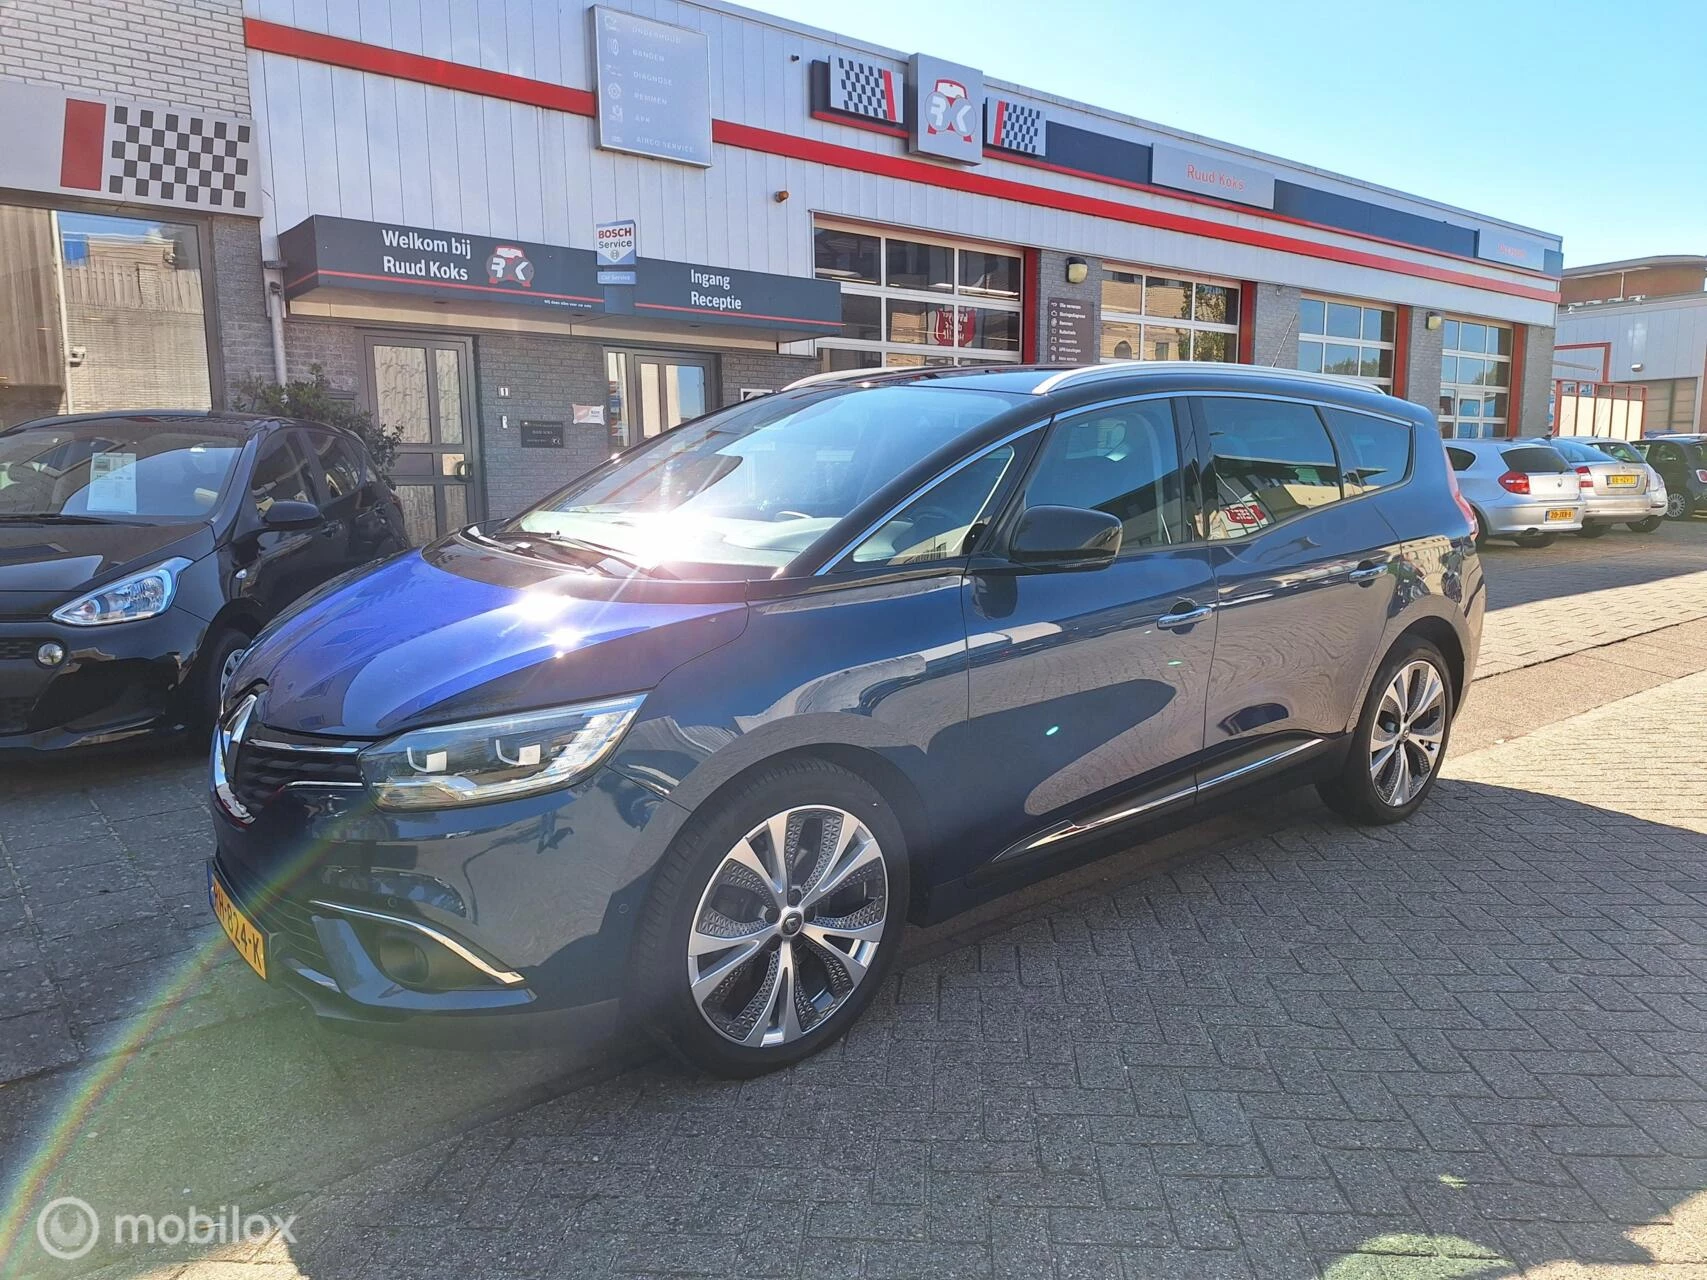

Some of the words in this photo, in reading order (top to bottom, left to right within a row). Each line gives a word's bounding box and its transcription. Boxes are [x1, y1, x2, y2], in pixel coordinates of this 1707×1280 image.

[1187, 163, 1216, 183] Ruud
[598, 227, 633, 239] BOSCH
[598, 238, 633, 249] Service
[382, 229, 448, 253] Welkom
[451, 235, 472, 260] bij
[383, 256, 426, 277] Ruud
[429, 260, 469, 281] Koks
[690, 269, 731, 291] Ingang
[690, 291, 742, 312] Receptie
